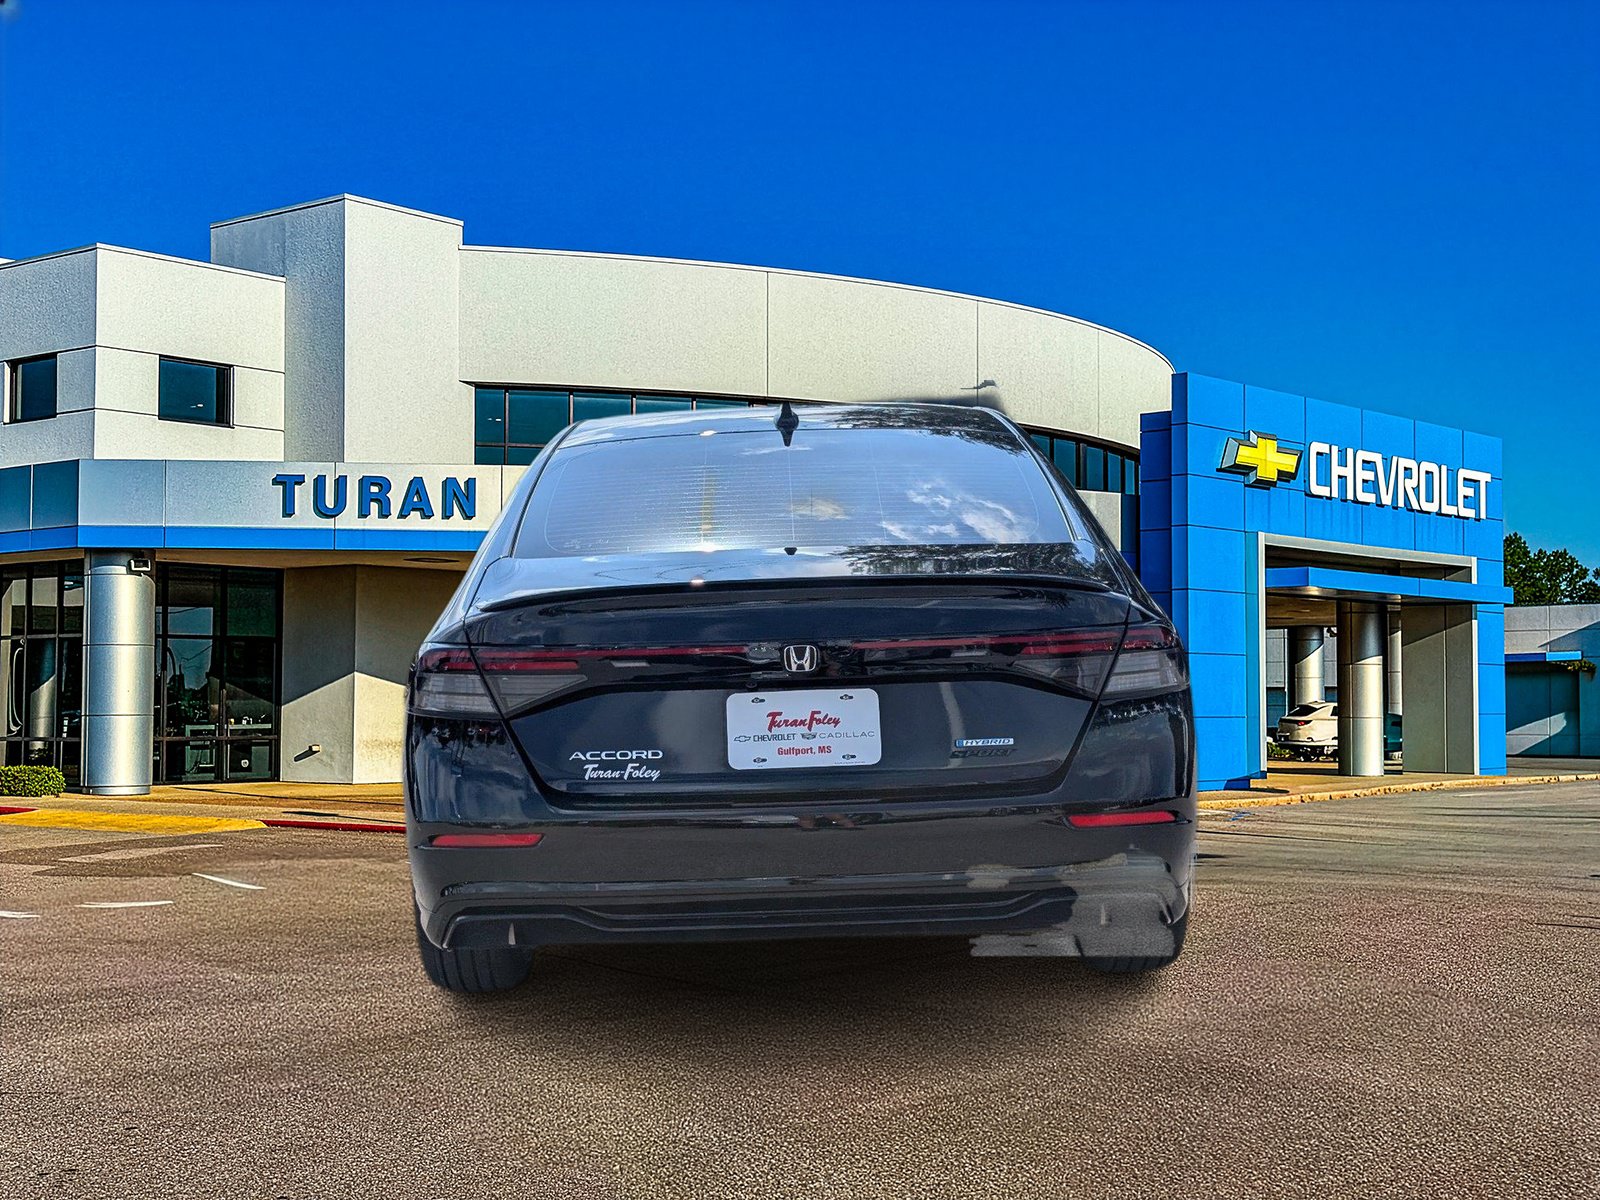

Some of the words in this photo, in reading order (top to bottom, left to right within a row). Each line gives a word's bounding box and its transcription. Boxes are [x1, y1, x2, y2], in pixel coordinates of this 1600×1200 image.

[1308, 441, 1492, 520] CHEVROLET
[272, 474, 477, 519] TURAN
[753, 733, 796, 743] CHEVROLET
[819, 731, 875, 739] CADILLAC
[964, 738, 1012, 746] HYBRID
[569, 750, 663, 760] ACCORD
[777, 747, 816, 756] Gulfport,
[818, 745, 832, 754] MS
